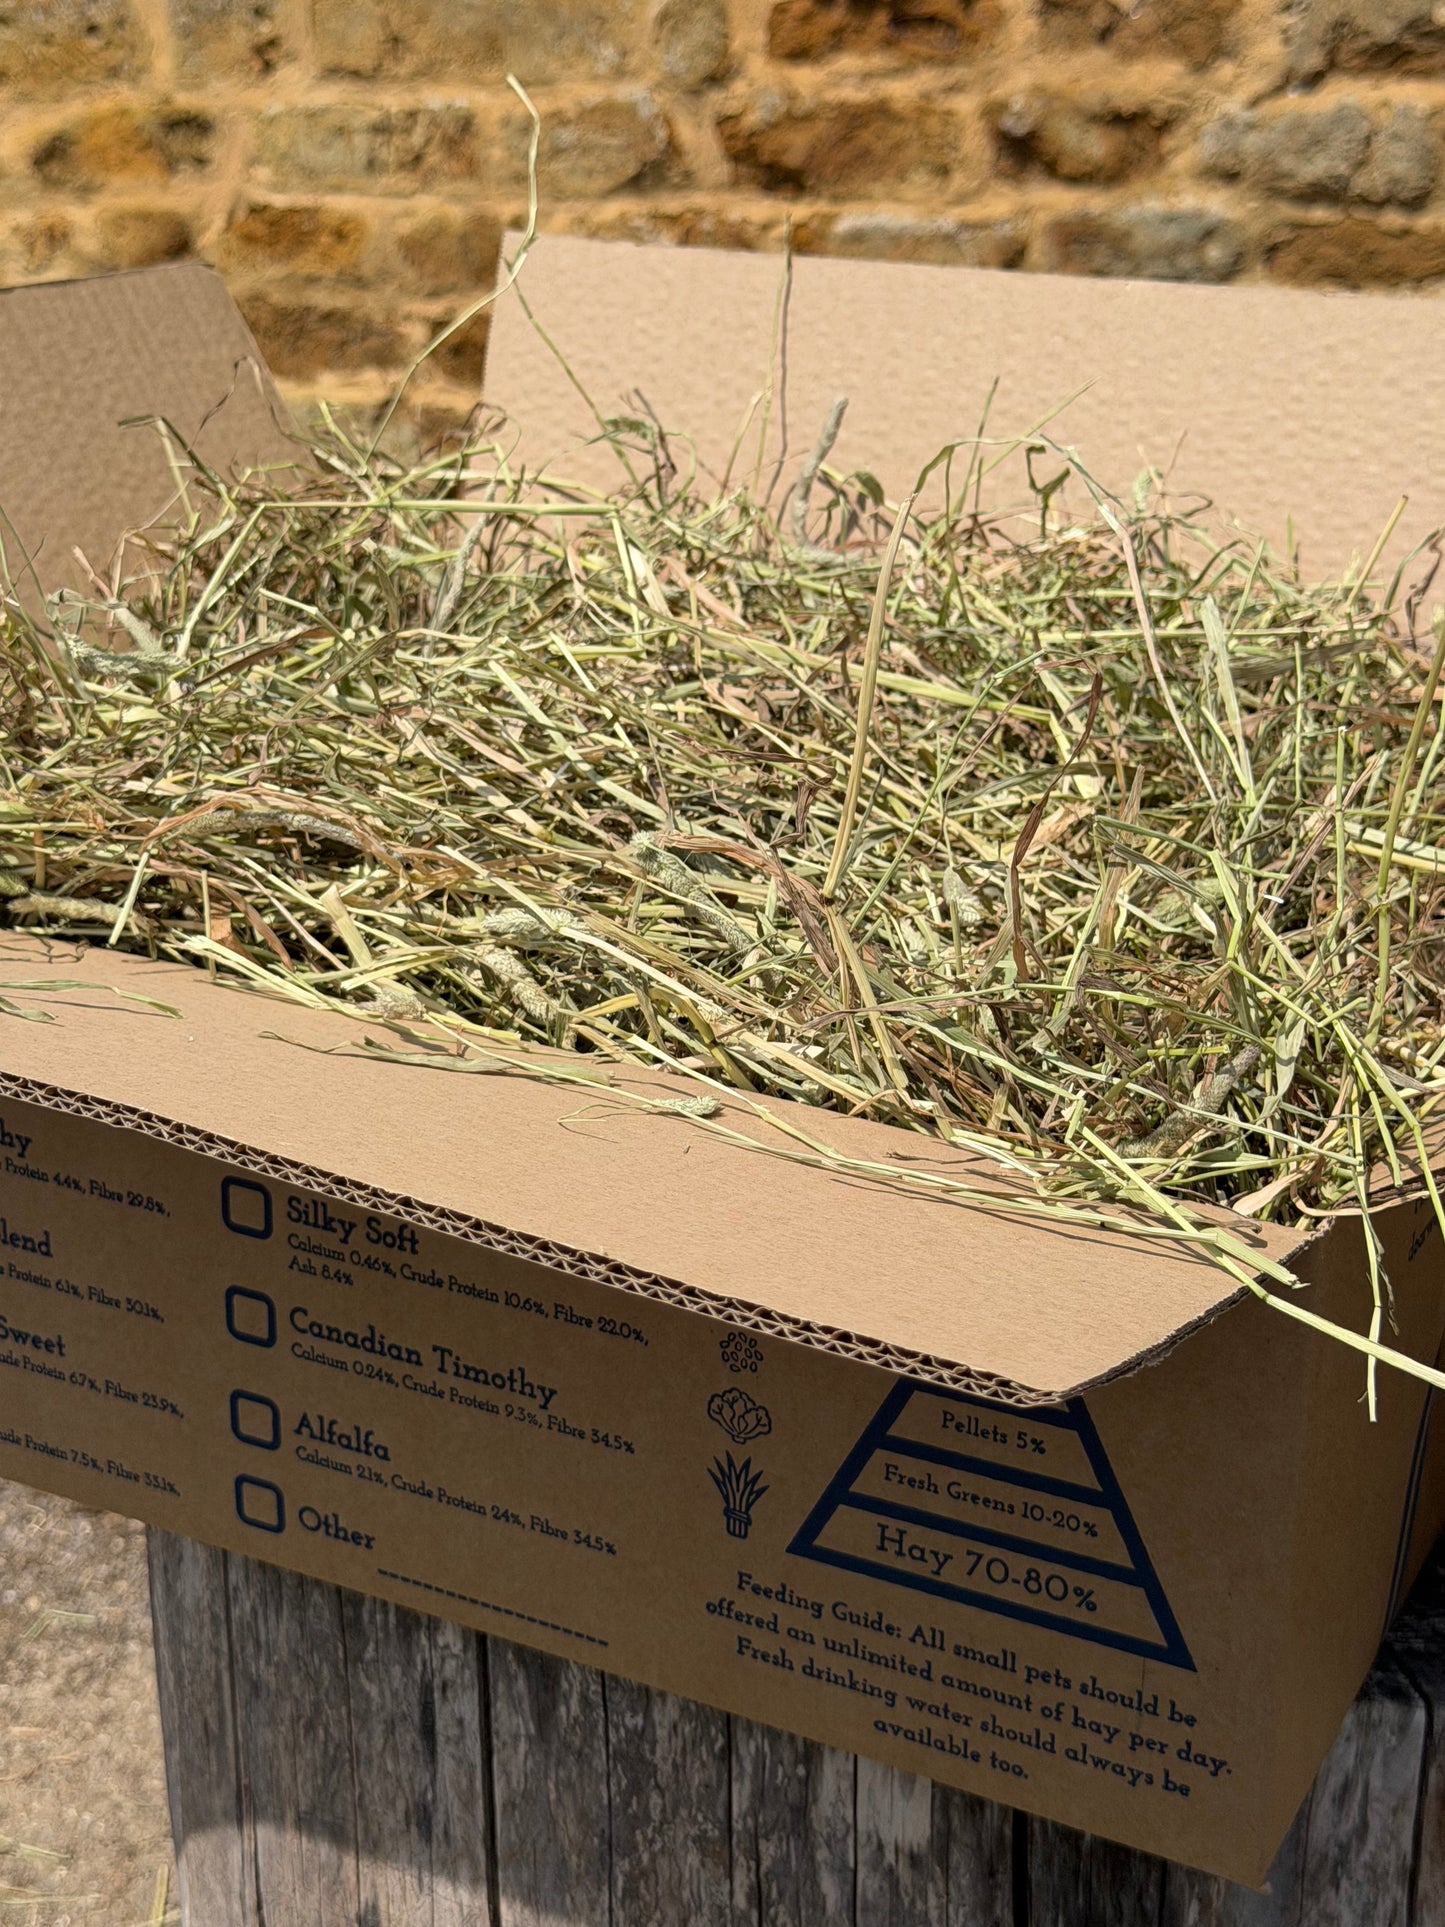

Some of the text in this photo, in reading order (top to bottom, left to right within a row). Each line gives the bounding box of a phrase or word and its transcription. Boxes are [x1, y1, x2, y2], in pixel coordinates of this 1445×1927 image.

[5, 1156, 170, 1217] Protein 4.4%, Fibre 29.8%,
[286, 1195, 420, 1256] Silky Soft
[7, 1263, 51, 1289] Protein
[87, 1286, 121, 1309] Fibre
[287, 1233, 649, 1346] Calcium 0.46%, Crude Protein 10.6%, Fibre 22.0%,
[288, 1255, 353, 1286] Ash 8.4%
[0, 1315, 65, 1357] Sweet
[289, 1306, 557, 1411] Canadian Timothy
[22, 1355, 66, 1381] Protein
[104, 1380, 138, 1403] Fibre
[291, 1342, 635, 1454] Calcium 0.24%, Crude Protein 9.3%, Fibre 34.5%
[25, 1434, 68, 1460] Protein
[107, 1460, 140, 1482] Fibre
[293, 1412, 391, 1462] Alfalfa
[941, 1409, 1046, 1455] Pellets 5%
[295, 1445, 352, 1475] Calcium
[391, 1474, 433, 1499] Crude
[437, 1487, 487, 1516] Protein
[491, 1505, 525, 1530] 24%,
[530, 1515, 568, 1540] Fibre
[574, 1529, 616, 1556] 34.5%
[298, 1506, 375, 1550] Other
[884, 1463, 1098, 1538] Fresh Greens 10-20%
[876, 1522, 1097, 1612] Hay 70-80%
[737, 1570, 1197, 1728] Feeding Guide: All small pets should be
[706, 1597, 1232, 1777] offered an unlimited amount of hay per day.
[736, 1635, 1191, 1797] Fresh drinking water should always be
[873, 1720, 1029, 1780] available too.
